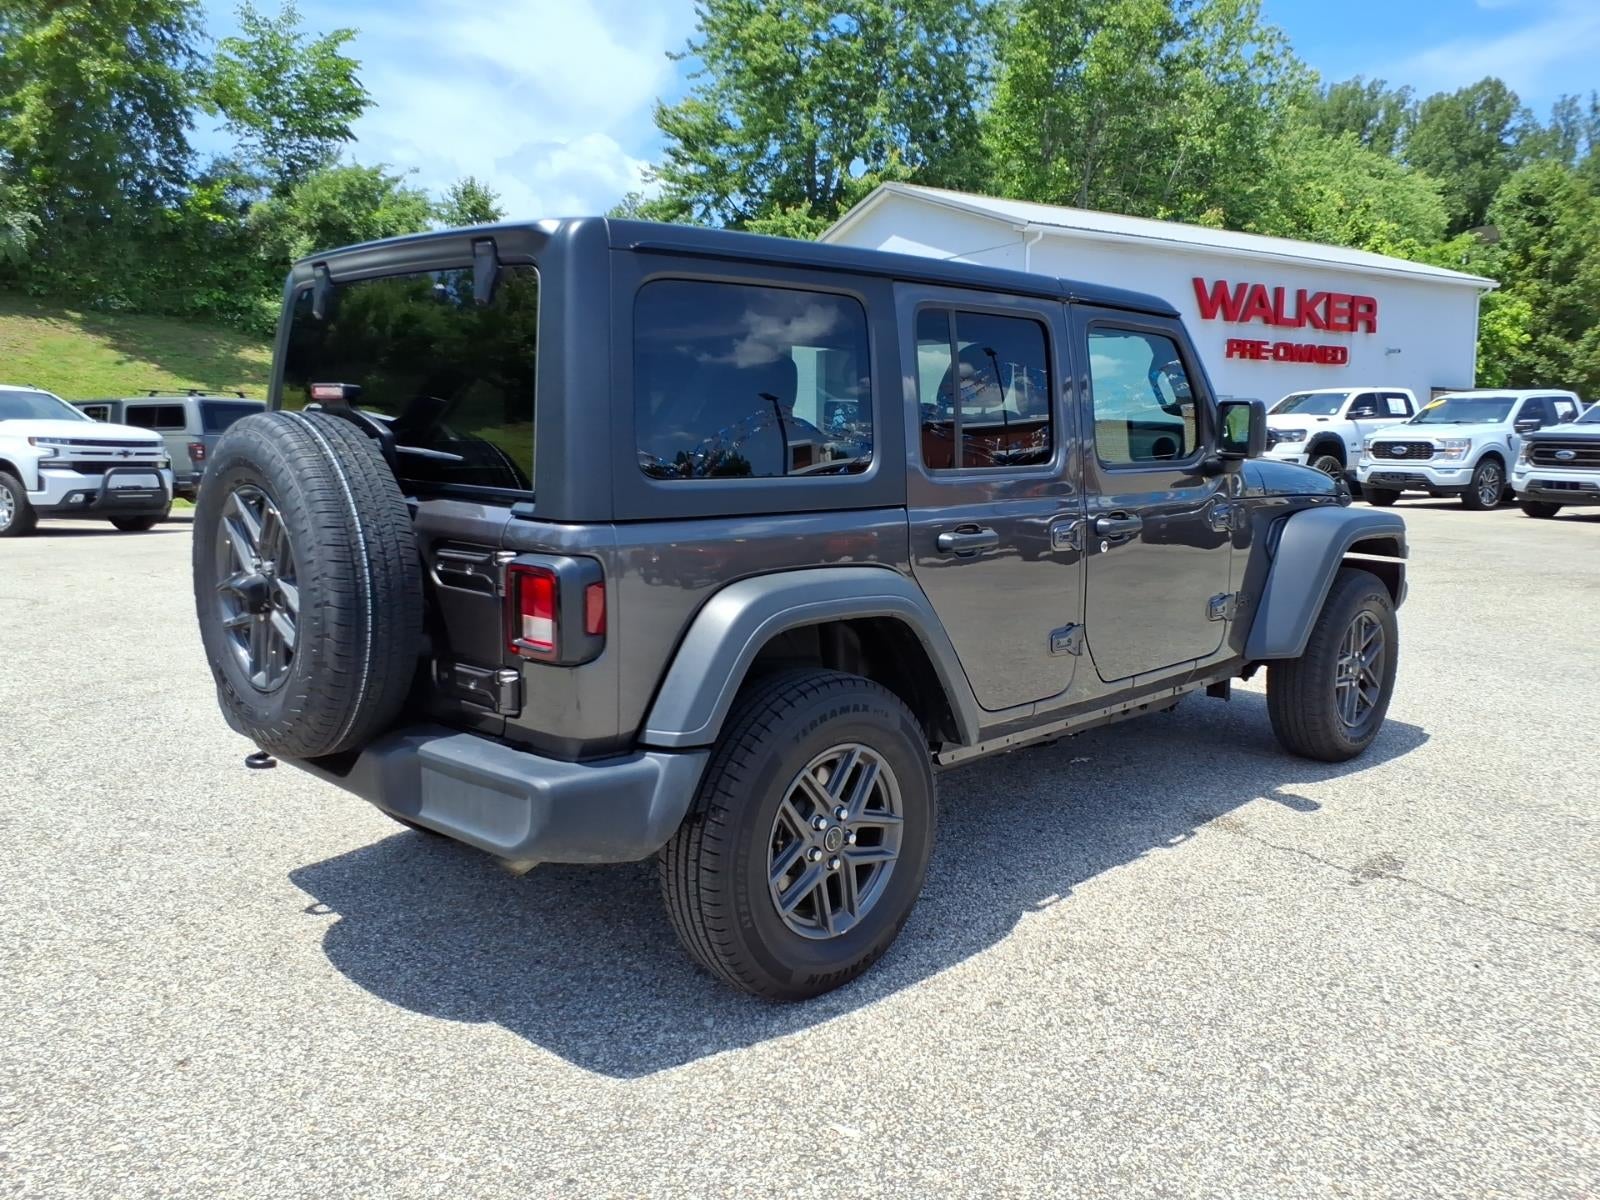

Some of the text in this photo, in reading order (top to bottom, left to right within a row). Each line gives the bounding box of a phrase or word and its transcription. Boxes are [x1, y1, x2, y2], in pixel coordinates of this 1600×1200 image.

[1192, 277, 1377, 333] WALKER
[1225, 338, 1348, 365] PRE-OWNED
[792, 703, 870, 744] TERRAMAX
